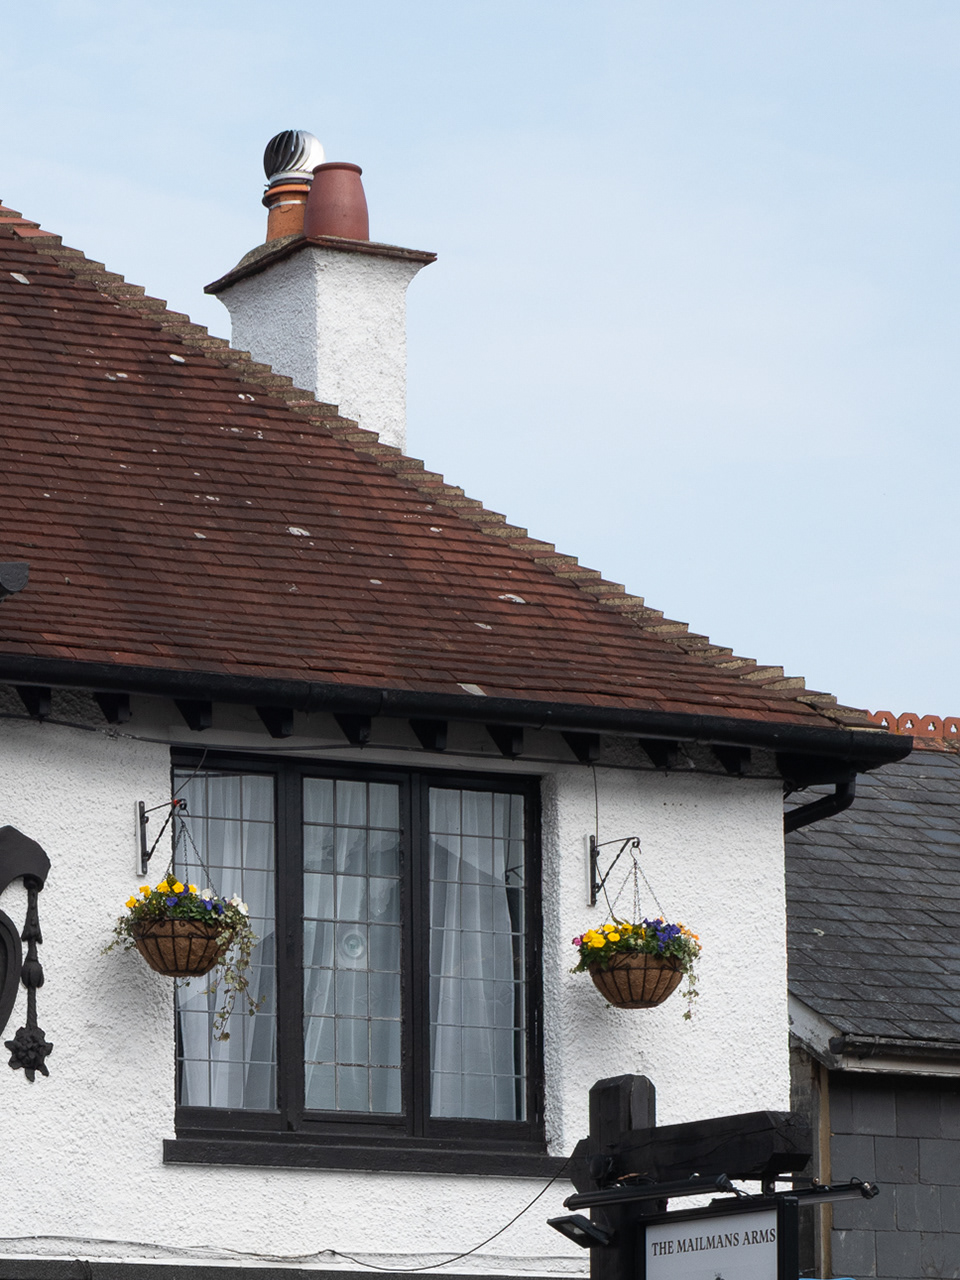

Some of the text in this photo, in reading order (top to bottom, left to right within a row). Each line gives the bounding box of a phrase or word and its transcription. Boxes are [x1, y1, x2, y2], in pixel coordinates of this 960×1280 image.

[651, 1228, 777, 1257] THE MAILMANS ARMS
